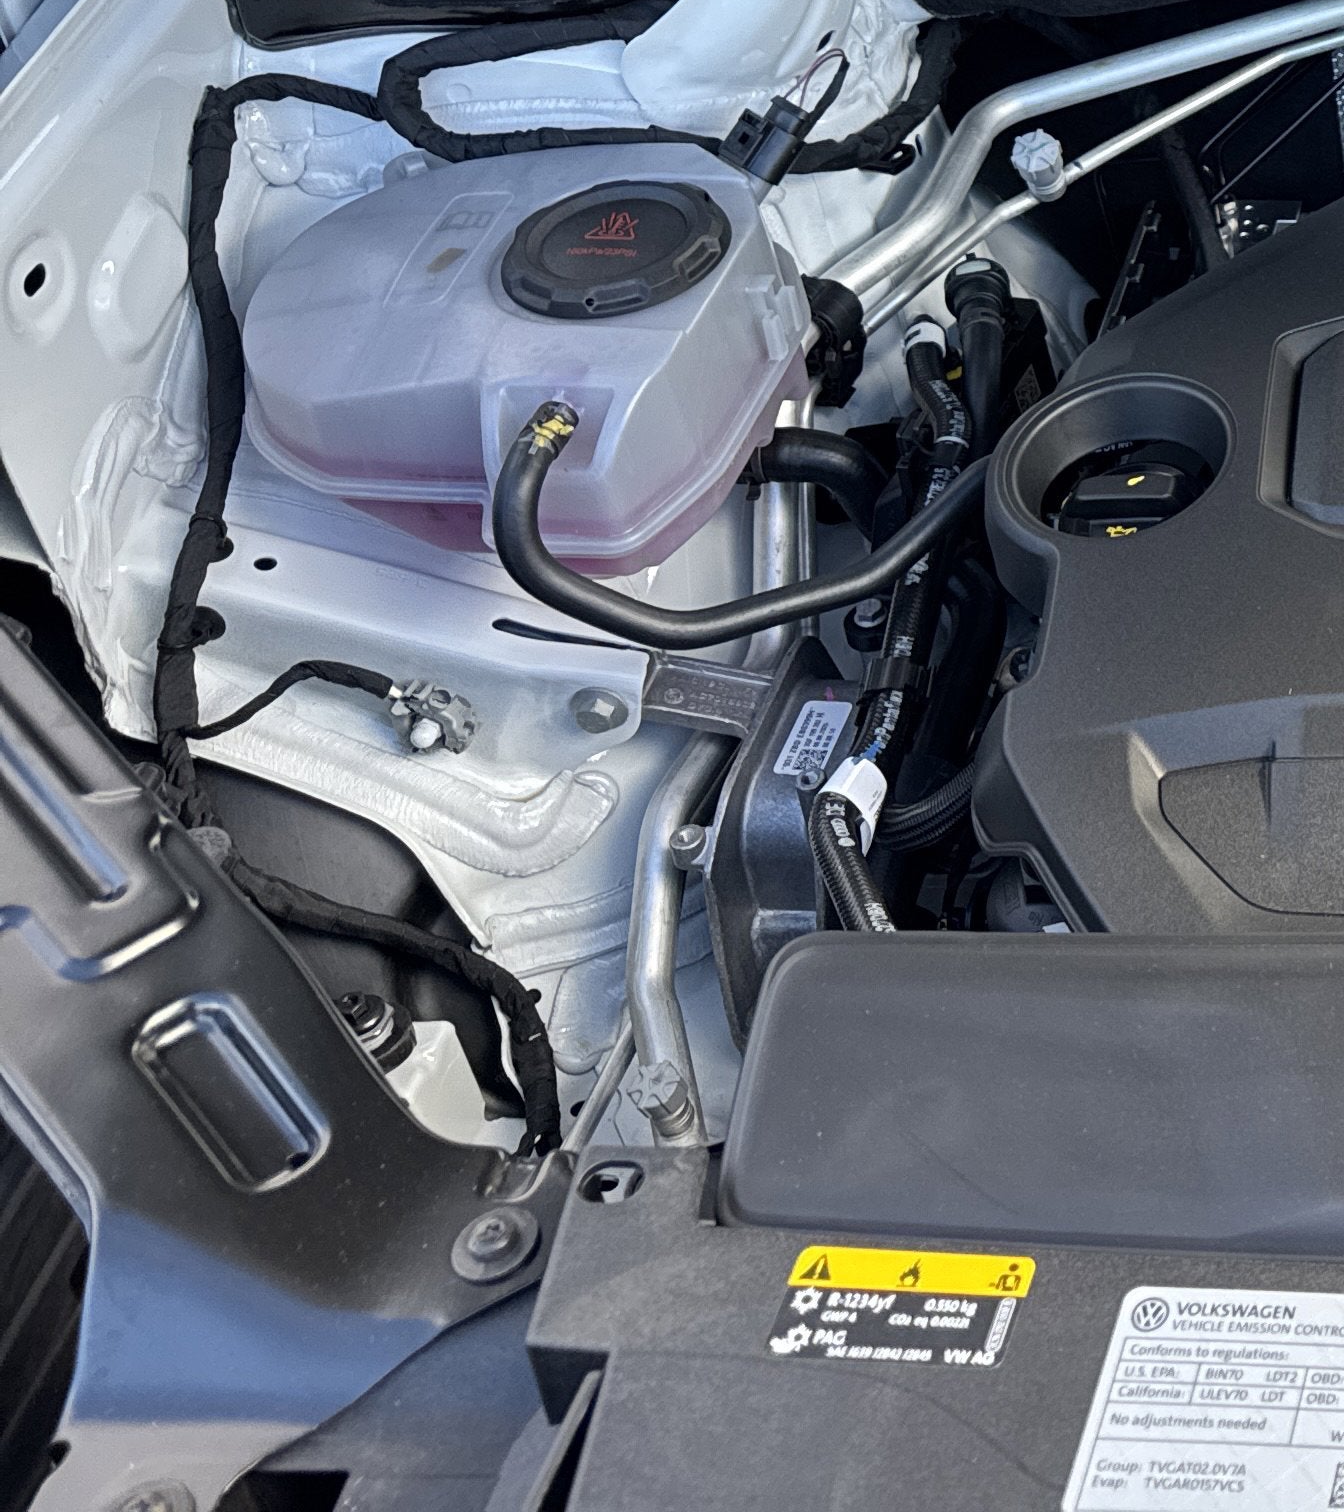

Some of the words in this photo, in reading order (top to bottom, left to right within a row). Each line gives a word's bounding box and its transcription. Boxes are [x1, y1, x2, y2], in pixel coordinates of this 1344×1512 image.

[826, 1292, 896, 1314] R-1234yf
[960, 1300, 977, 1317] kg
[1177, 1301, 1296, 1319] VOLKSWAGEN
[1172, 1319, 1224, 1332] VEHICLE
[1228, 1321, 1290, 1334] EMISSION
[812, 1329, 847, 1345] PAG
[944, 1349, 972, 1364] VW
[970, 1350, 996, 1365] AG
[1130, 1343, 1191, 1357] Conforms
[1196, 1347, 1209, 1357] to
[1212, 1348, 1289, 1362] regulations:
[1205, 1368, 1243, 1381] BIN70
[1265, 1369, 1298, 1383] LDT2
[1311, 1372, 1344, 1385] OBD:
[1118, 1385, 1184, 1399] California:
[1199, 1388, 1248, 1401] ULEV70
[1260, 1390, 1286, 1403] LDT
[1306, 1393, 1339, 1405] OBD:
[1110, 1413, 1128, 1426] No
[1131, 1414, 1214, 1430] adjustments
[1217, 1418, 1267, 1431] needed
[1096, 1459, 1141, 1475] Group:
[1091, 1475, 1128, 1490] Evap:
